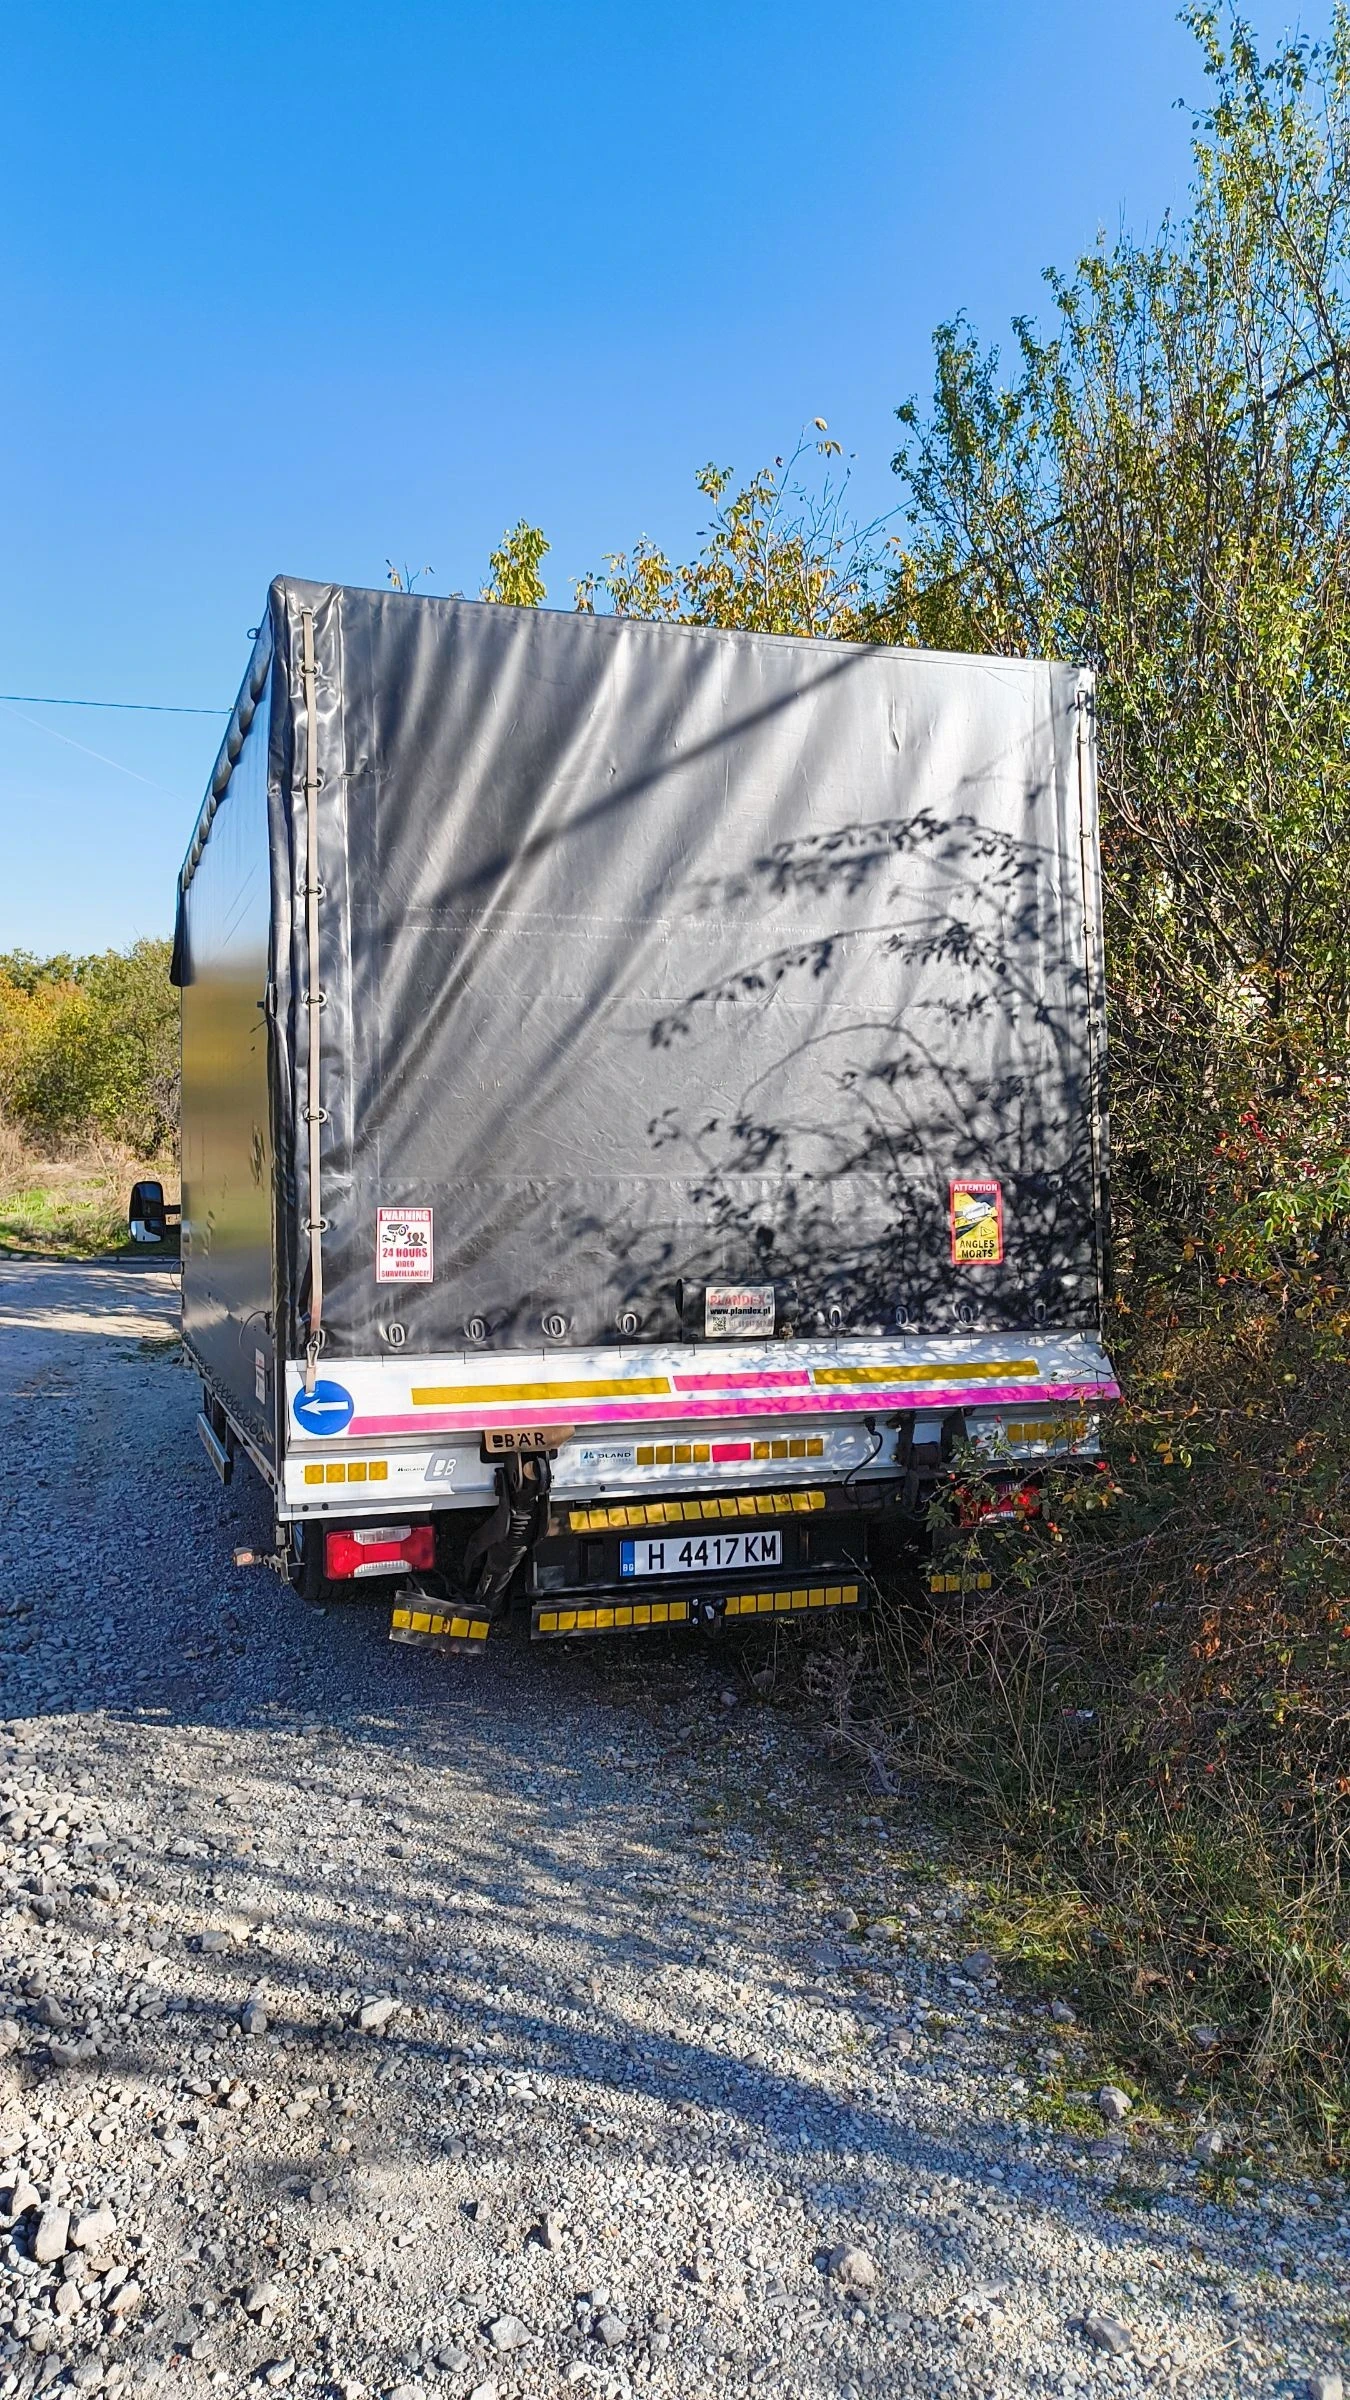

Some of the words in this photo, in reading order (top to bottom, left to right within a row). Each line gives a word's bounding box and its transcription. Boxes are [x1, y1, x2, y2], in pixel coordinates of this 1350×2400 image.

[954, 1183, 998, 1191] ATTENTION
[381, 1210, 430, 1221] WARNING
[960, 1240, 995, 1248] ANGLES
[382, 1248, 394, 1257] 24
[396, 1248, 428, 1257] HOURS
[961, 1249, 993, 1258] MORTS
[709, 1295, 766, 1306] PLANDEX
[710, 1307, 771, 1316] www.plandex.pl
[504, 1432, 546, 1447] BÄR
[648, 1543, 665, 1570] H
[622, 1563, 634, 1572] BG
